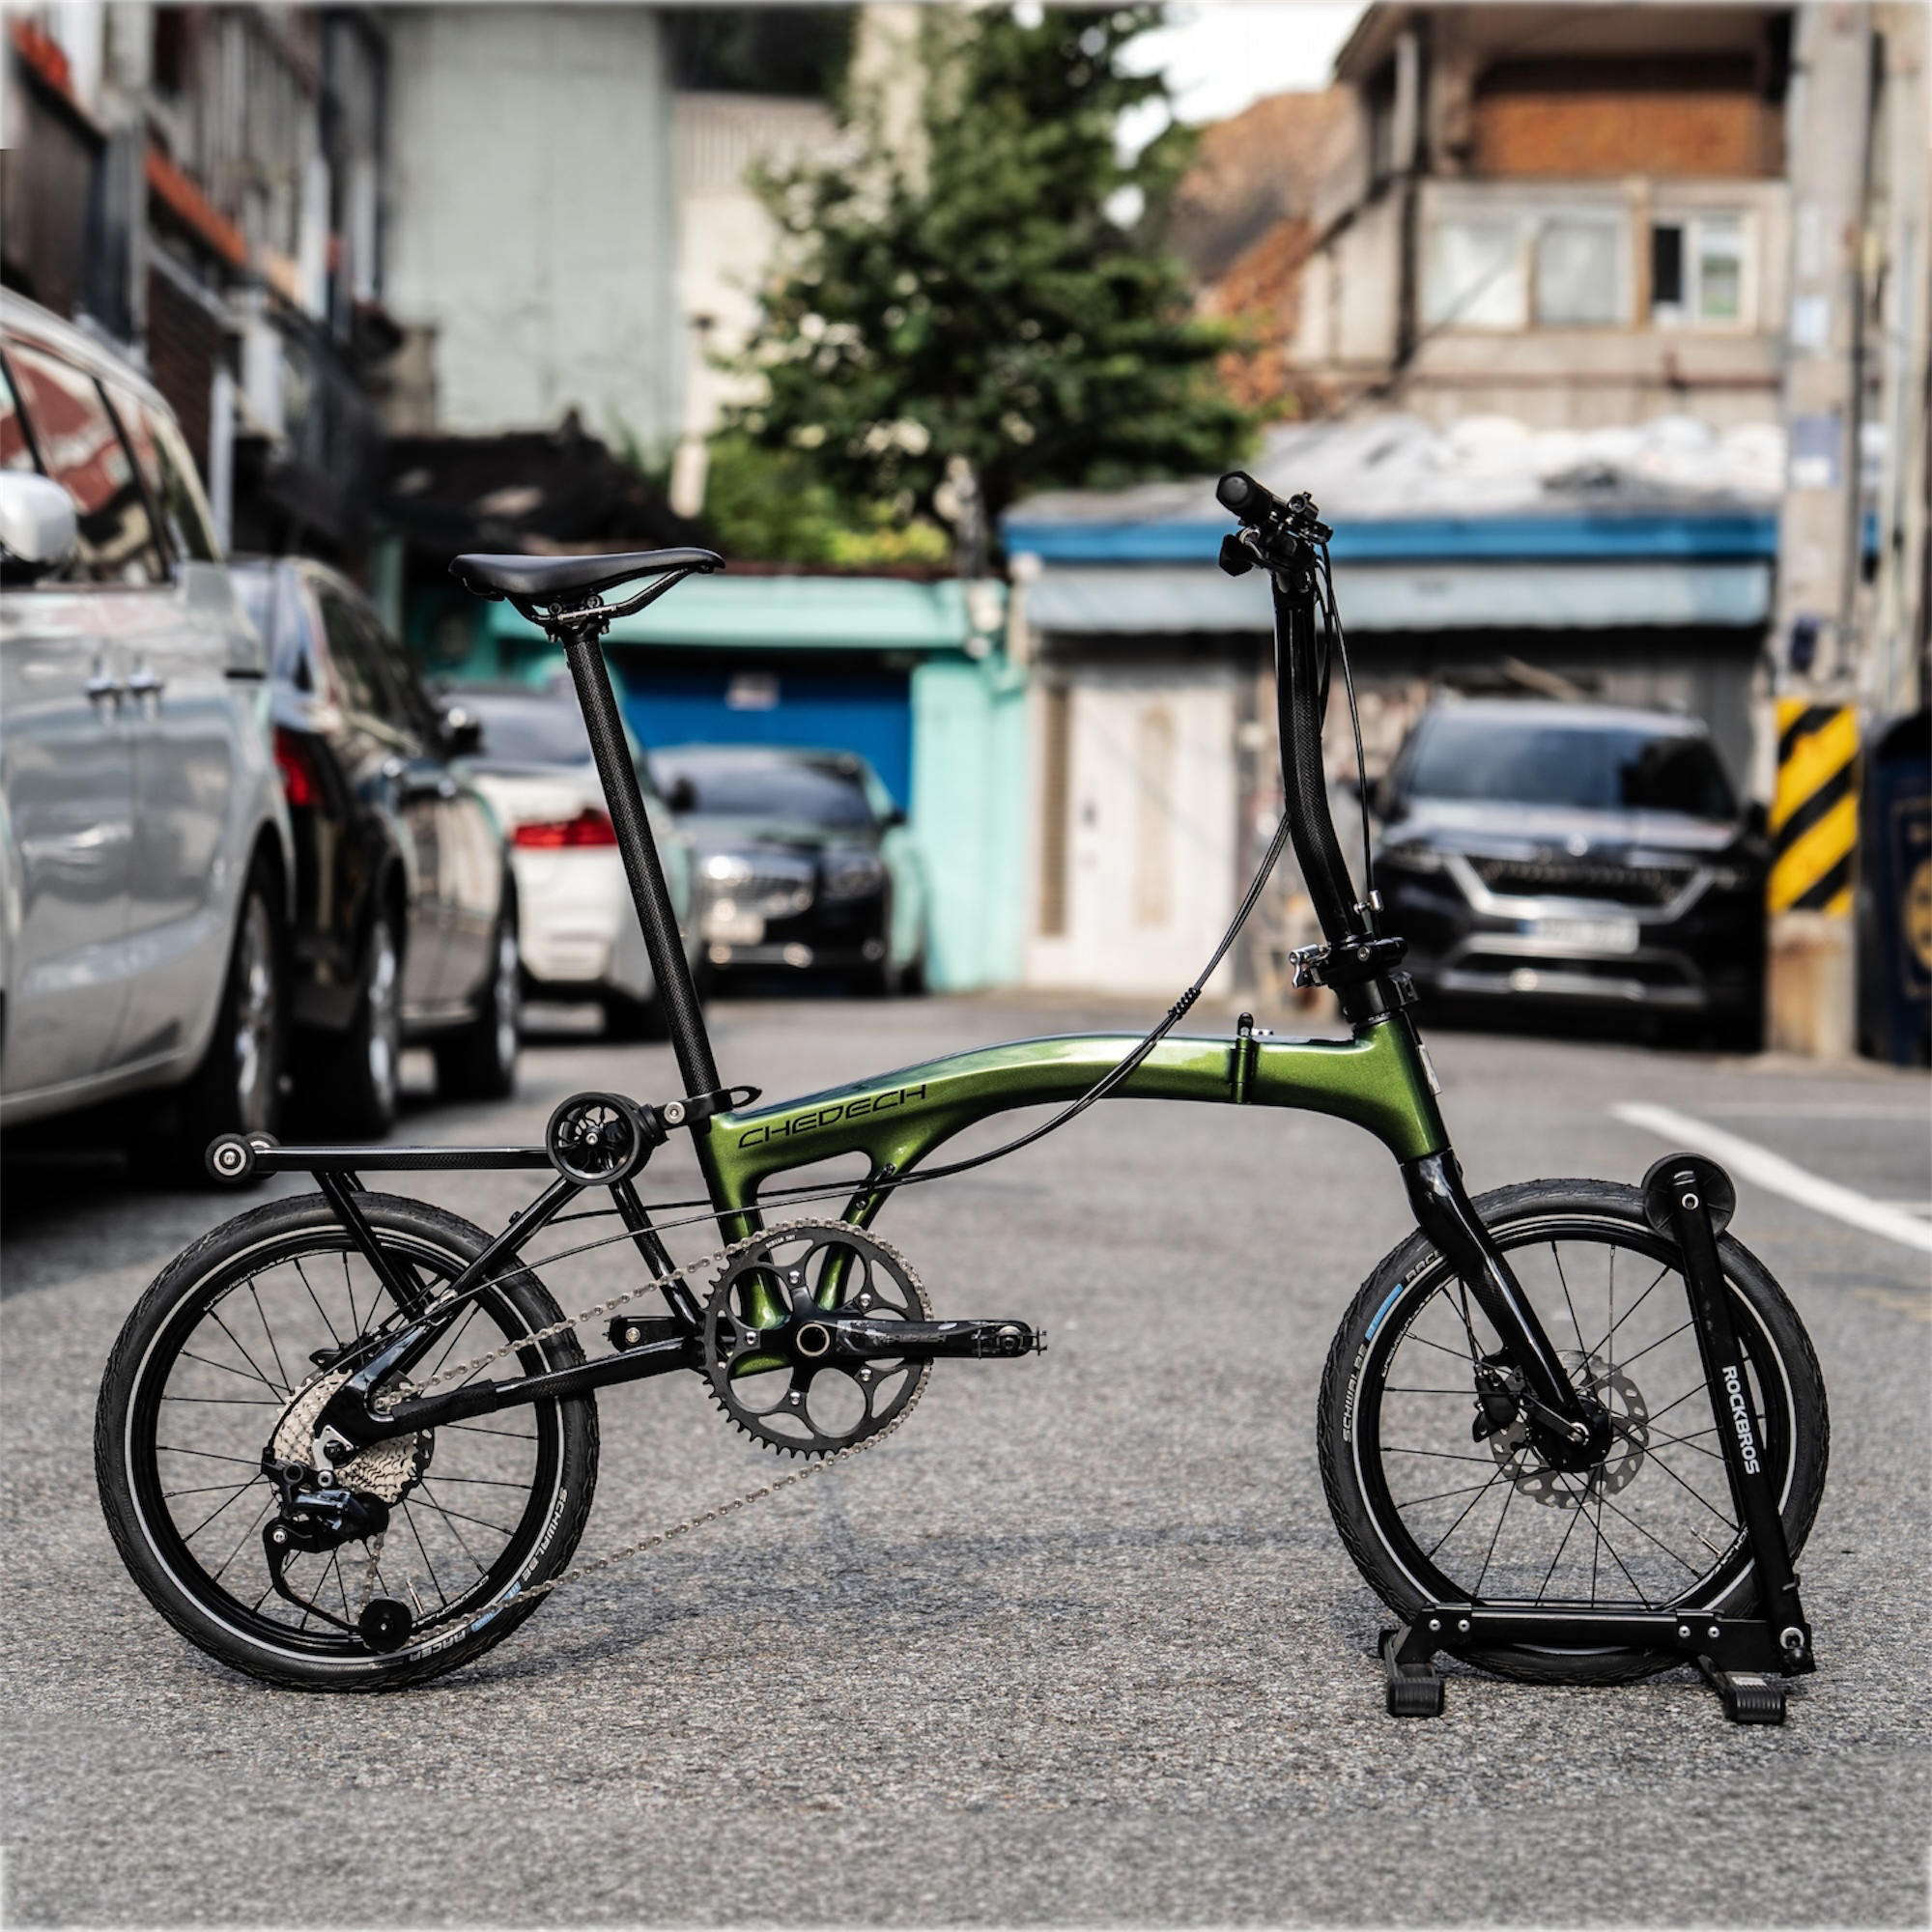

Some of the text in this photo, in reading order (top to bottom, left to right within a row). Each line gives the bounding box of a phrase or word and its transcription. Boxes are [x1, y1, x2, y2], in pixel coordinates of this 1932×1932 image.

[738, 1084, 926, 1150] CHEDECH
[1342, 1343, 1369, 1443] SCHWALBE
[1721, 1365, 1761, 1475] ROCKBROS
[409, 1487, 568, 1662] SCHWALBE RACER
